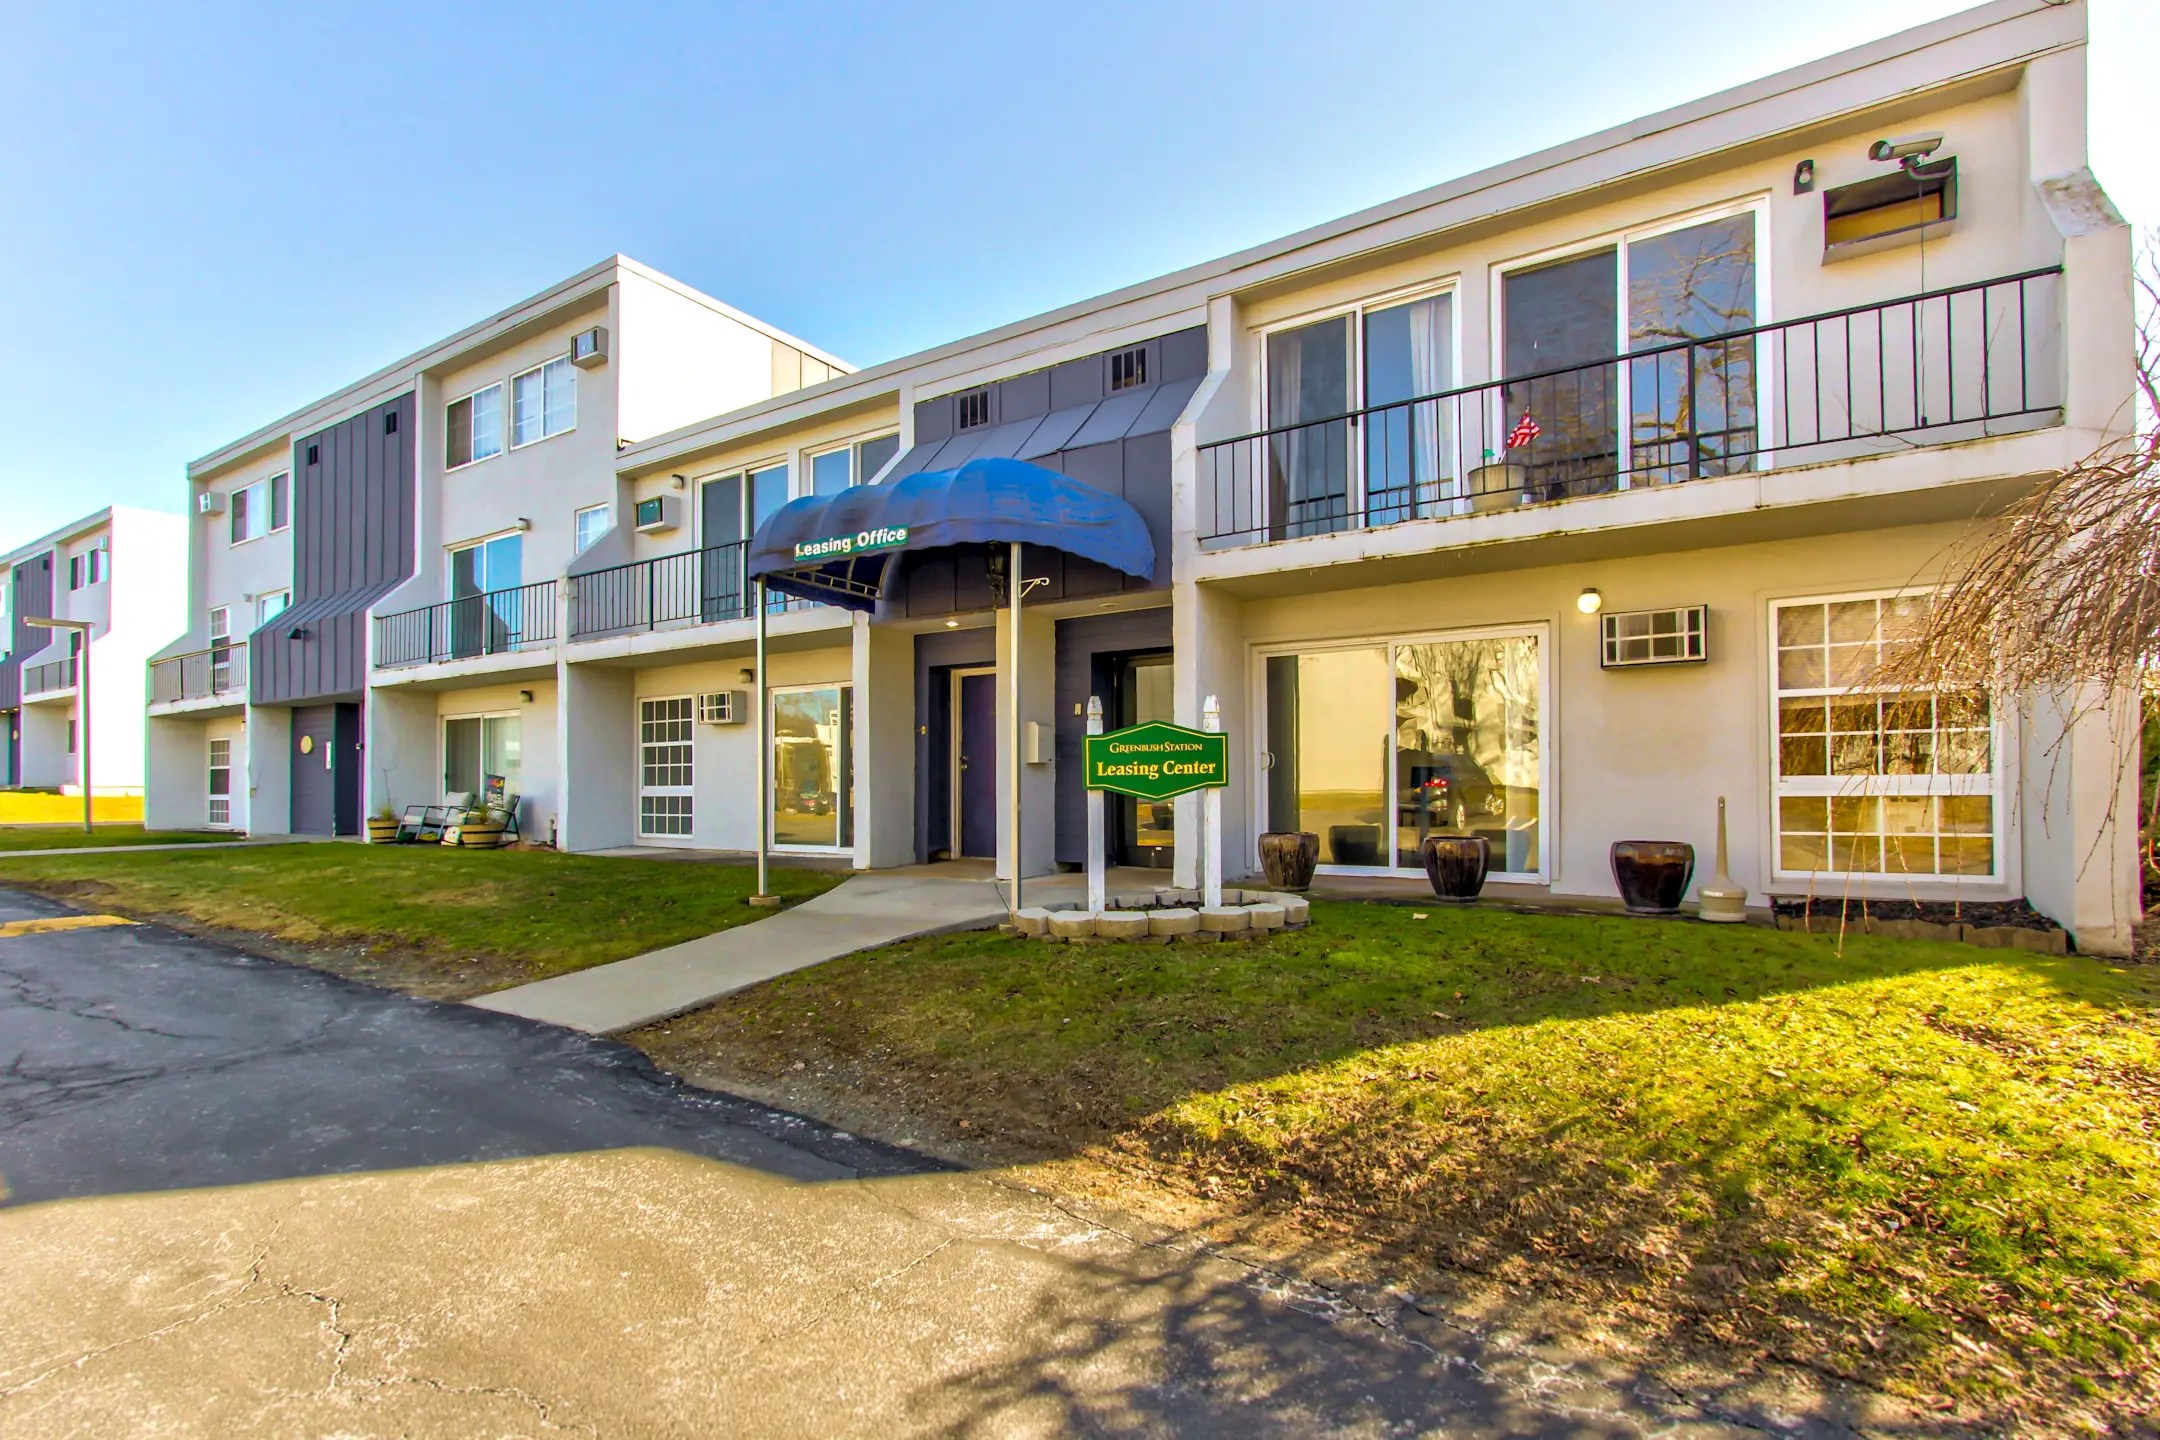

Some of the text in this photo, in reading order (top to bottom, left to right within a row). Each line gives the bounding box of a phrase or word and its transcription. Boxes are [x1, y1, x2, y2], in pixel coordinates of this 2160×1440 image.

[795, 528, 905, 557] Leasing Office
[1109, 741, 1203, 754] GREENBUSH STATION
[1097, 760, 1216, 780] Leasing Center
